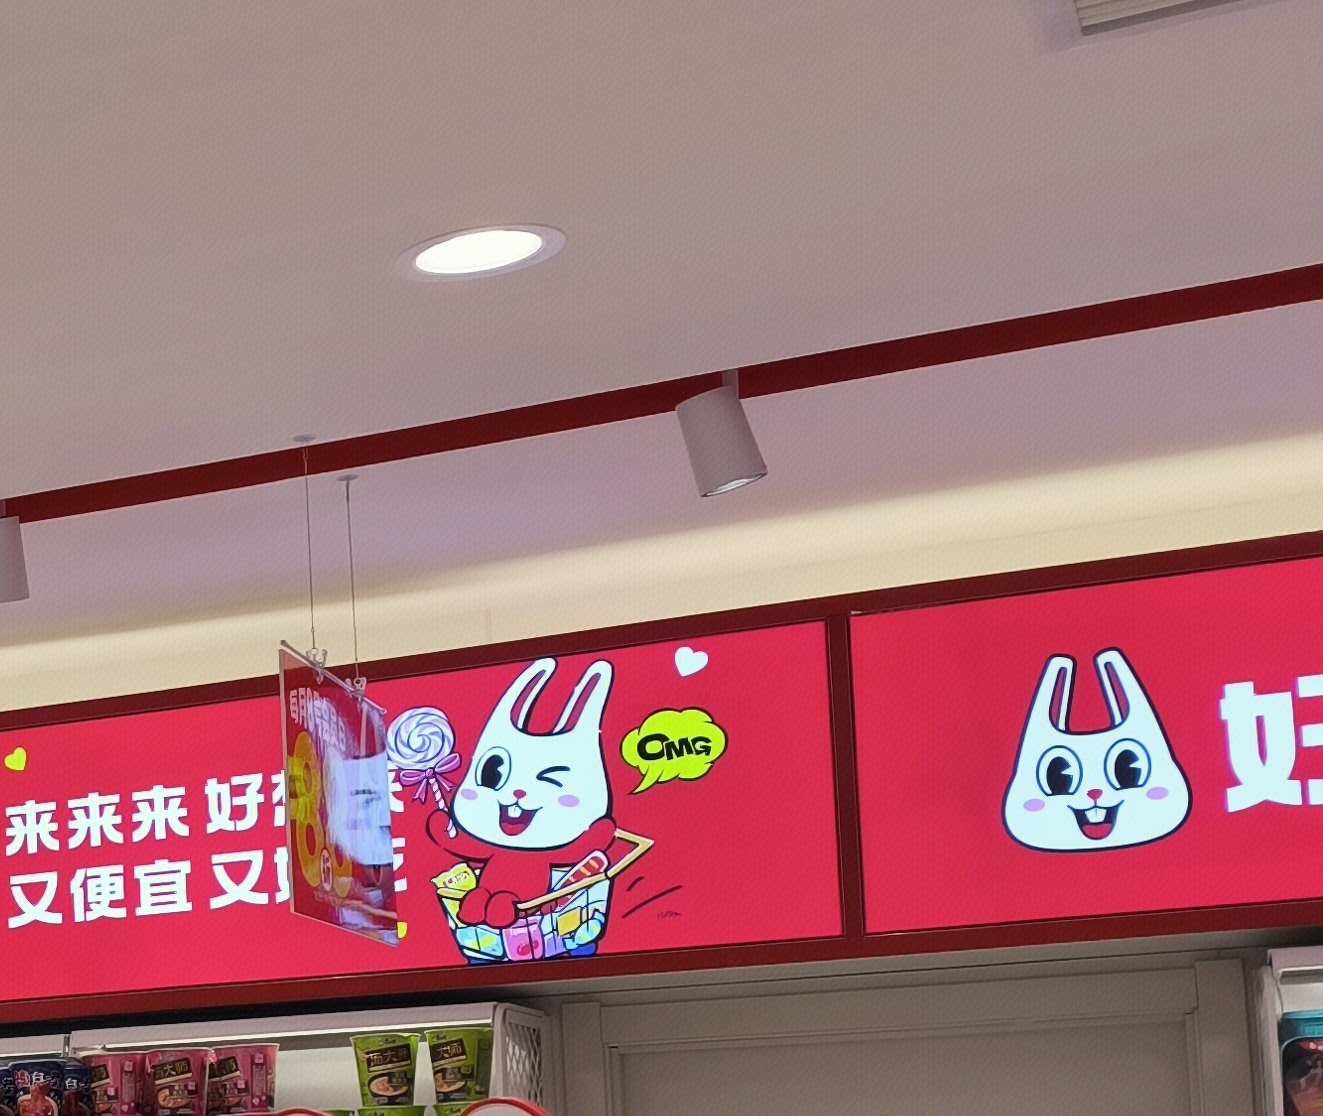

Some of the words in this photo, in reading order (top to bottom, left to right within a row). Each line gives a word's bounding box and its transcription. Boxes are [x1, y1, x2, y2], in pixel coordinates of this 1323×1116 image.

[637, 733, 712, 761] OMG
[5, 783, 190, 857] 来来来
[8, 859, 193, 929] 又便宜
